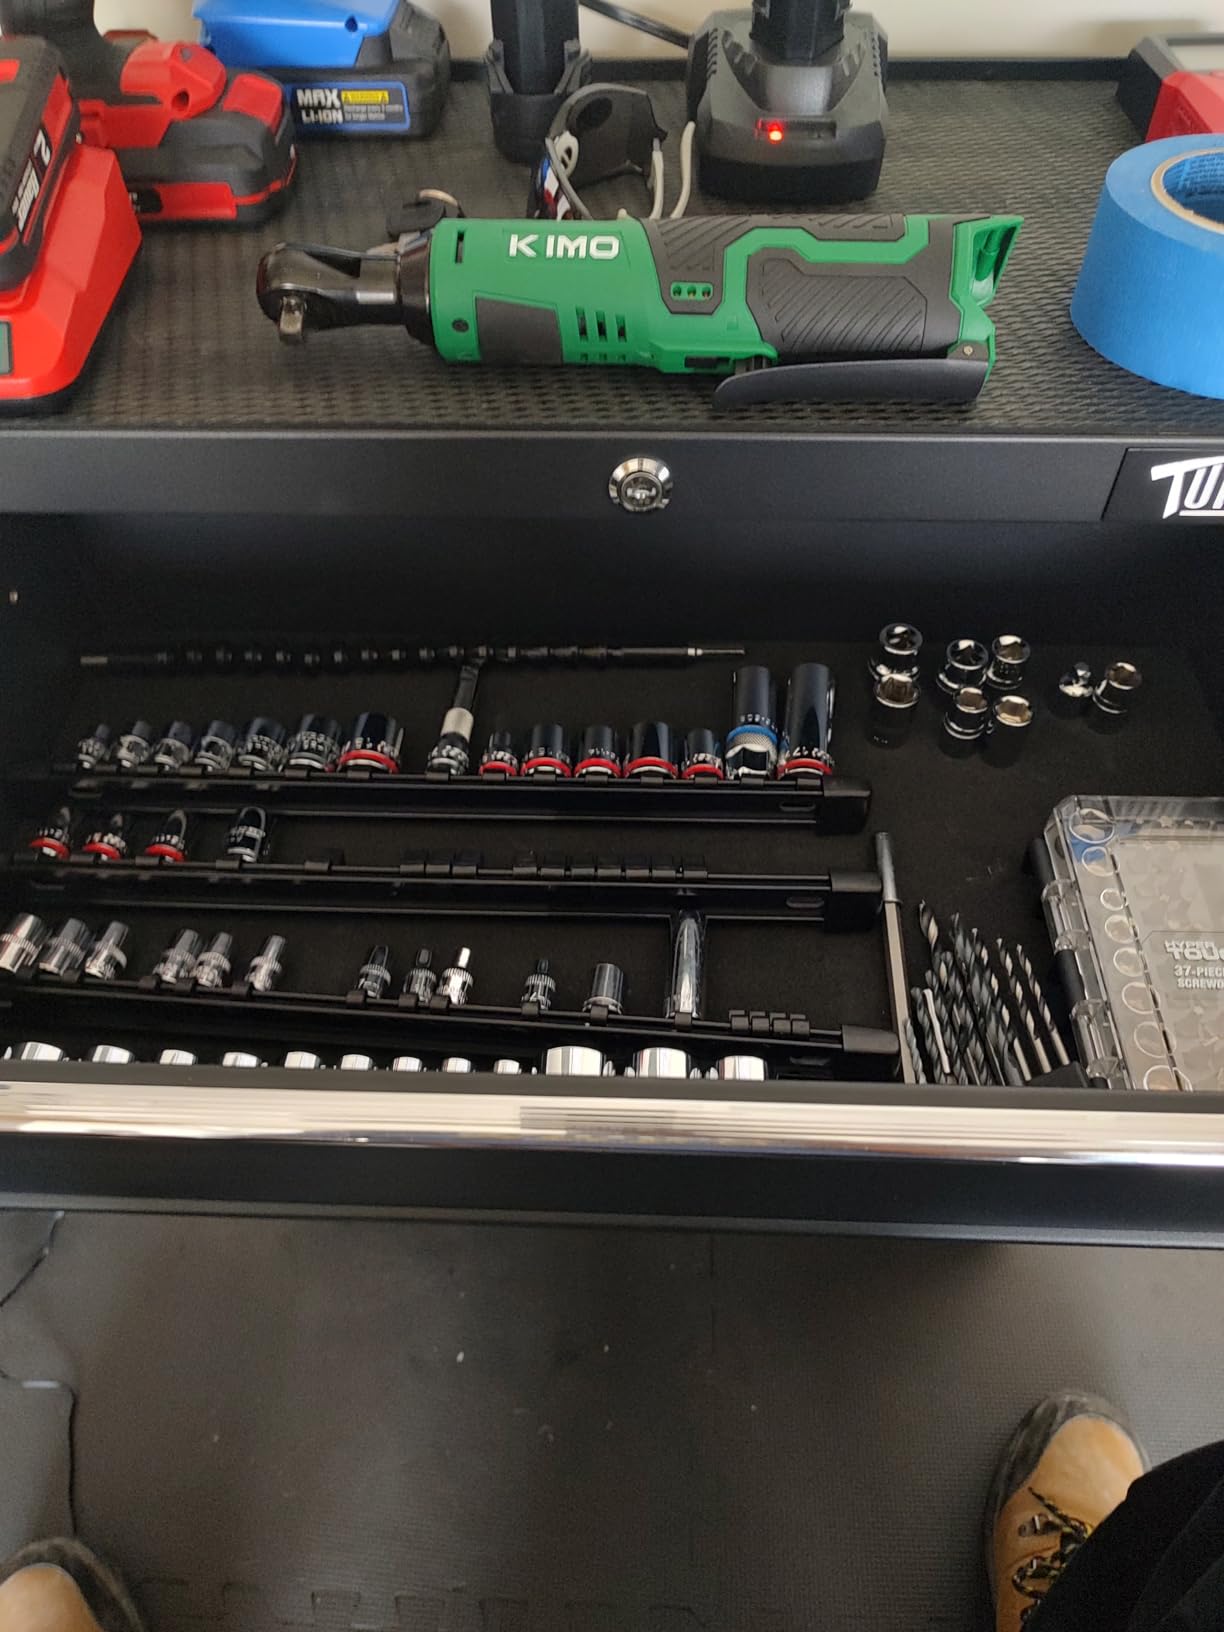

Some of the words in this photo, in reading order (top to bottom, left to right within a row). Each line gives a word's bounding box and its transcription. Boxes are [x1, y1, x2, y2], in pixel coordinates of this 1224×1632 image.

[296, 88, 341, 109] MAX
[508, 233, 620, 260] KIMO
[1173, 964, 1224, 977] 37-PIEC
